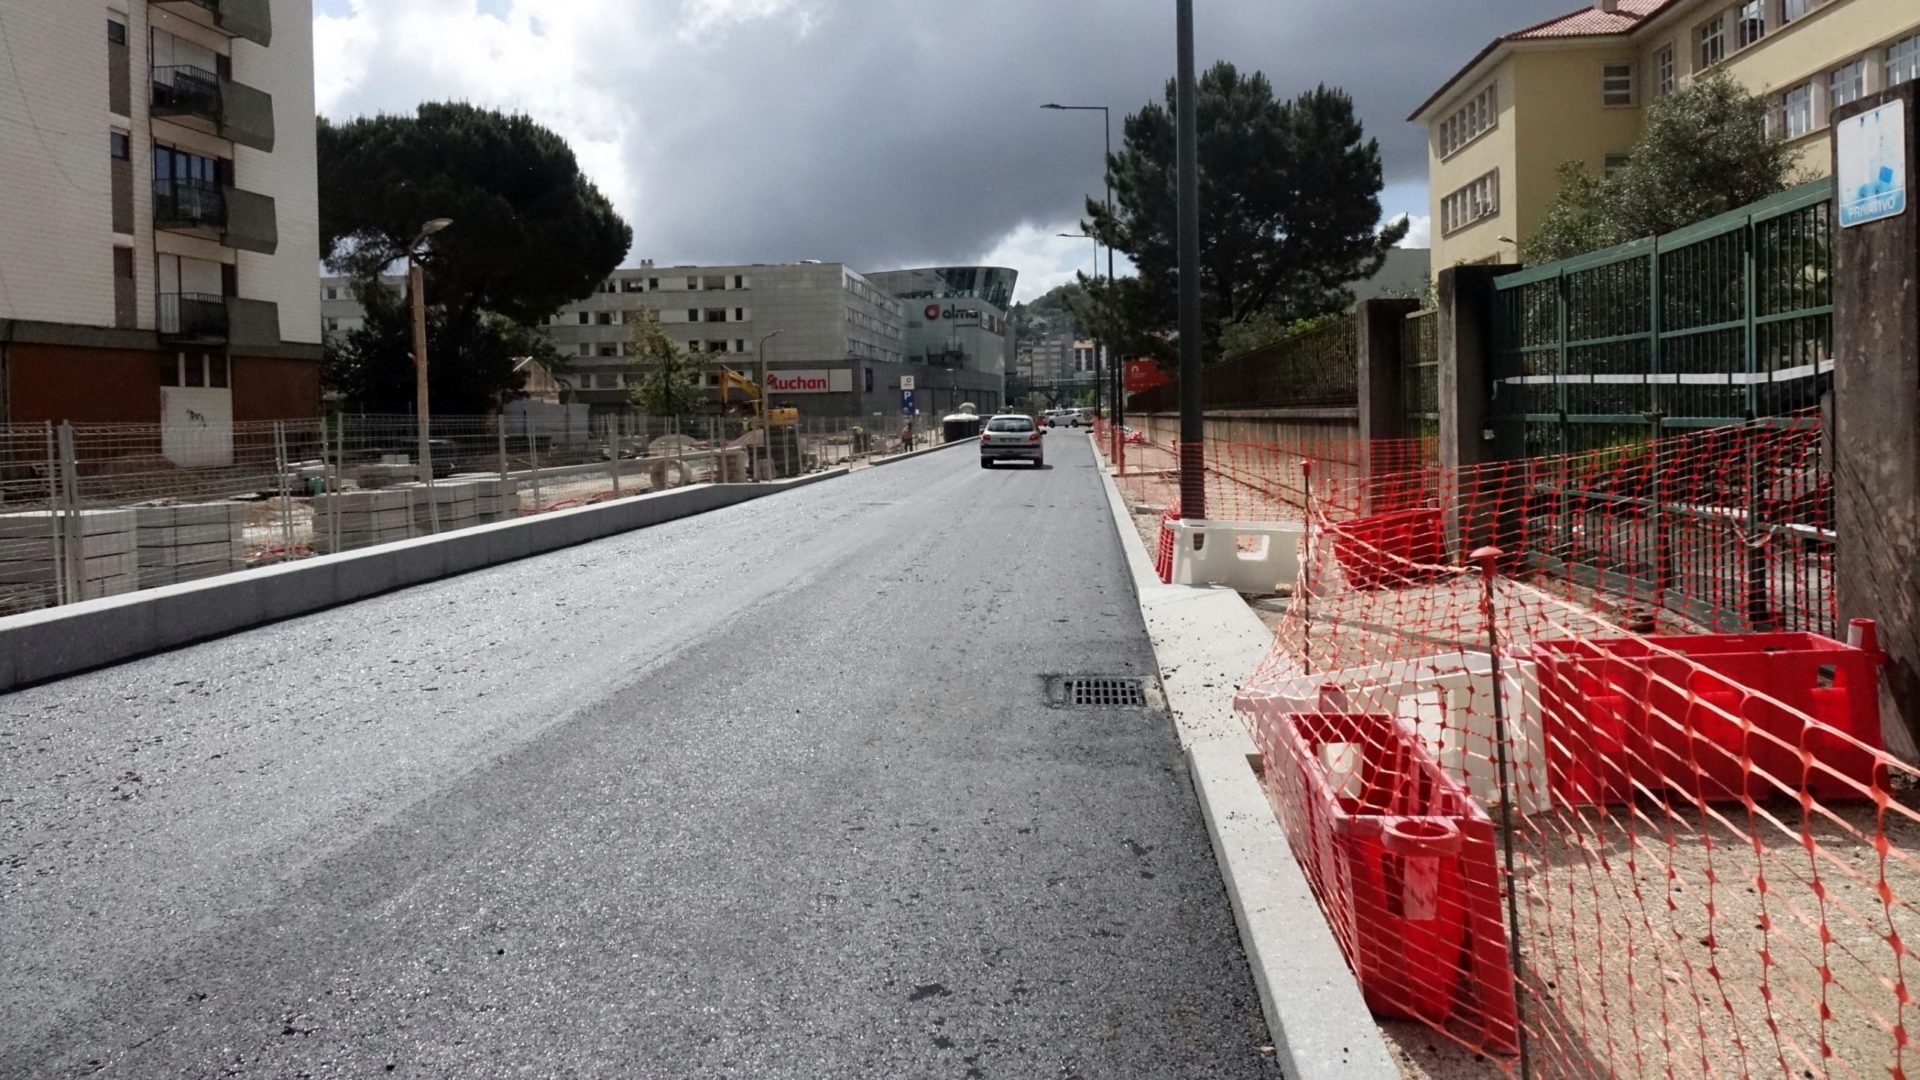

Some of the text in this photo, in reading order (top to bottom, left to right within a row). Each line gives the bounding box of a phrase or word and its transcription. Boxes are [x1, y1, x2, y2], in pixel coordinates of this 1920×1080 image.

[1848, 196, 1896, 219] PRIVATIVO
[942, 304, 978, 319] alma
[767, 374, 826, 389] Auchan
[903, 391, 912, 401] P
